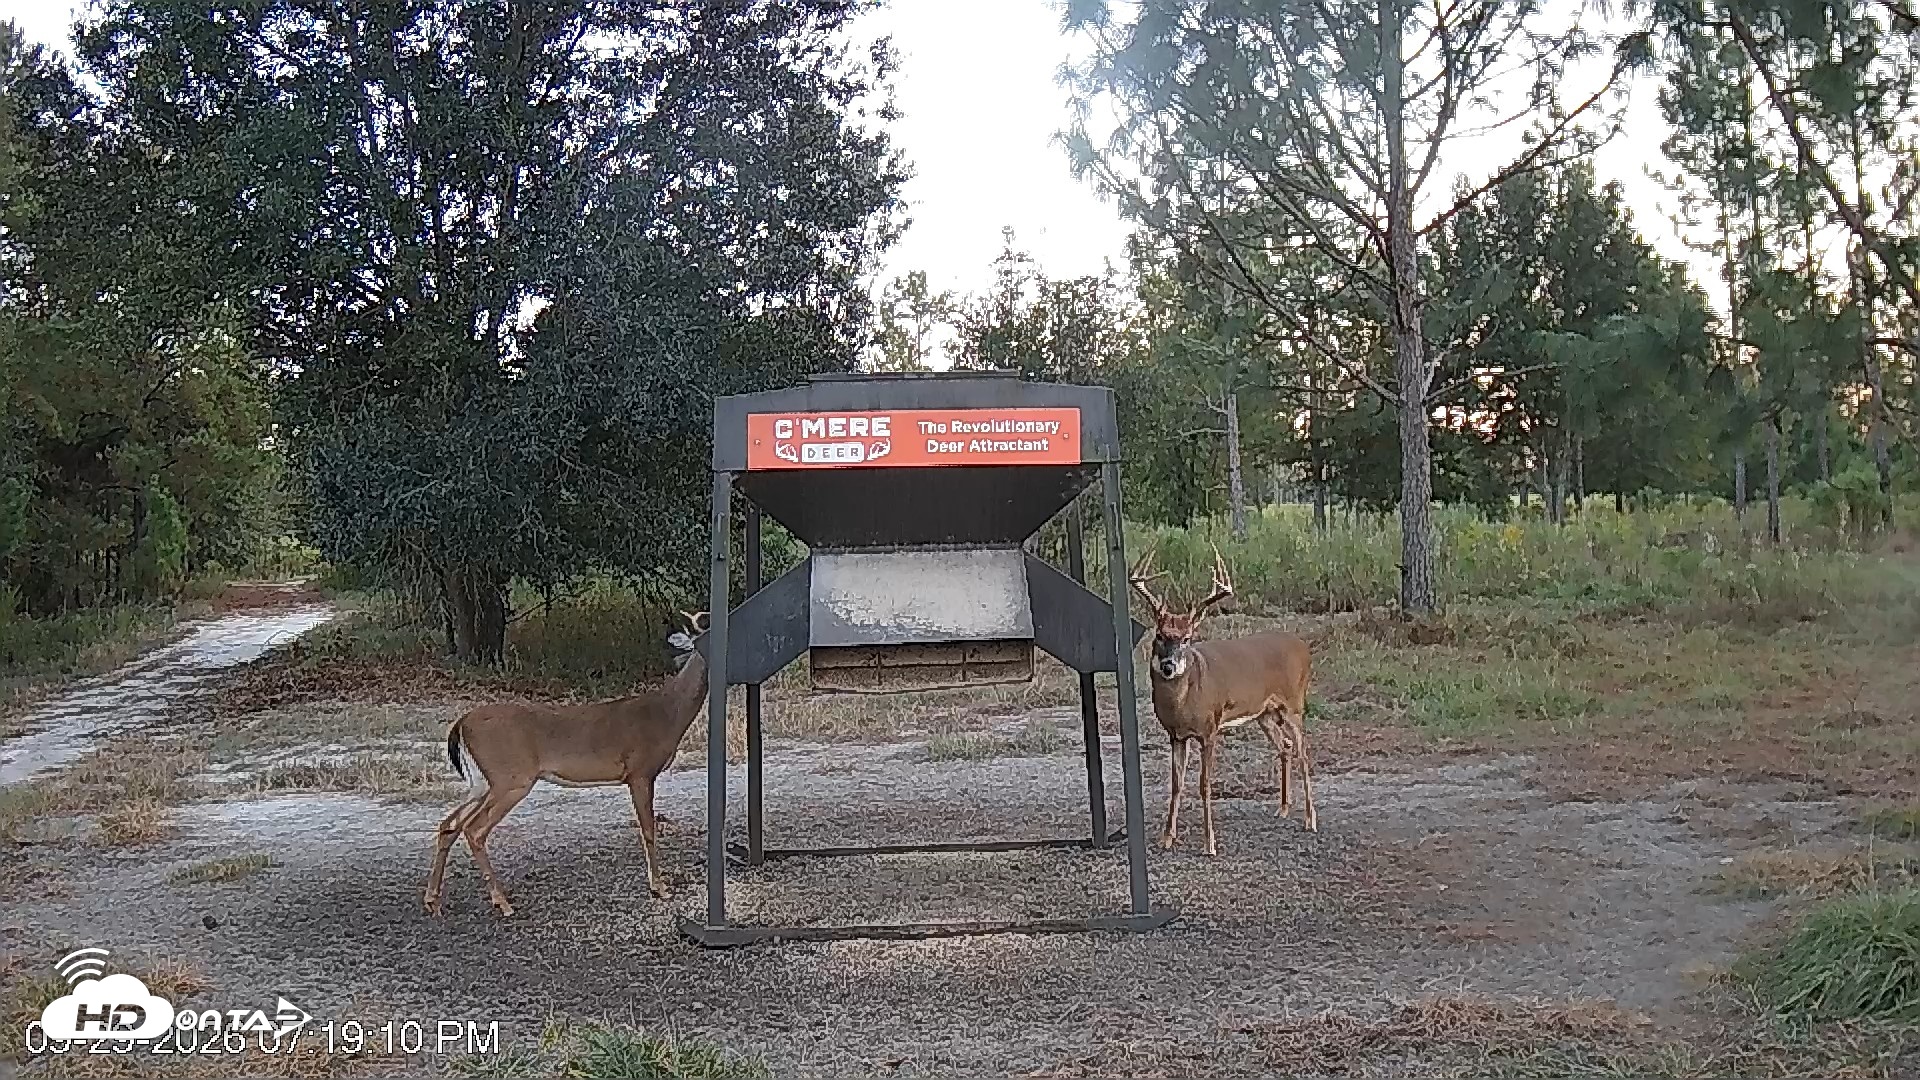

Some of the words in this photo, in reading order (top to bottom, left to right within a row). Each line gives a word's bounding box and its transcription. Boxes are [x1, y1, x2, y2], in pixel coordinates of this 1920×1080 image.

[774, 416, 892, 440] C'MERE
[917, 420, 947, 434] The
[950, 418, 1061, 436] Revolutionary
[806, 446, 861, 460] DEER
[926, 439, 965, 454] Deer
[968, 438, 1050, 453] Attractant
